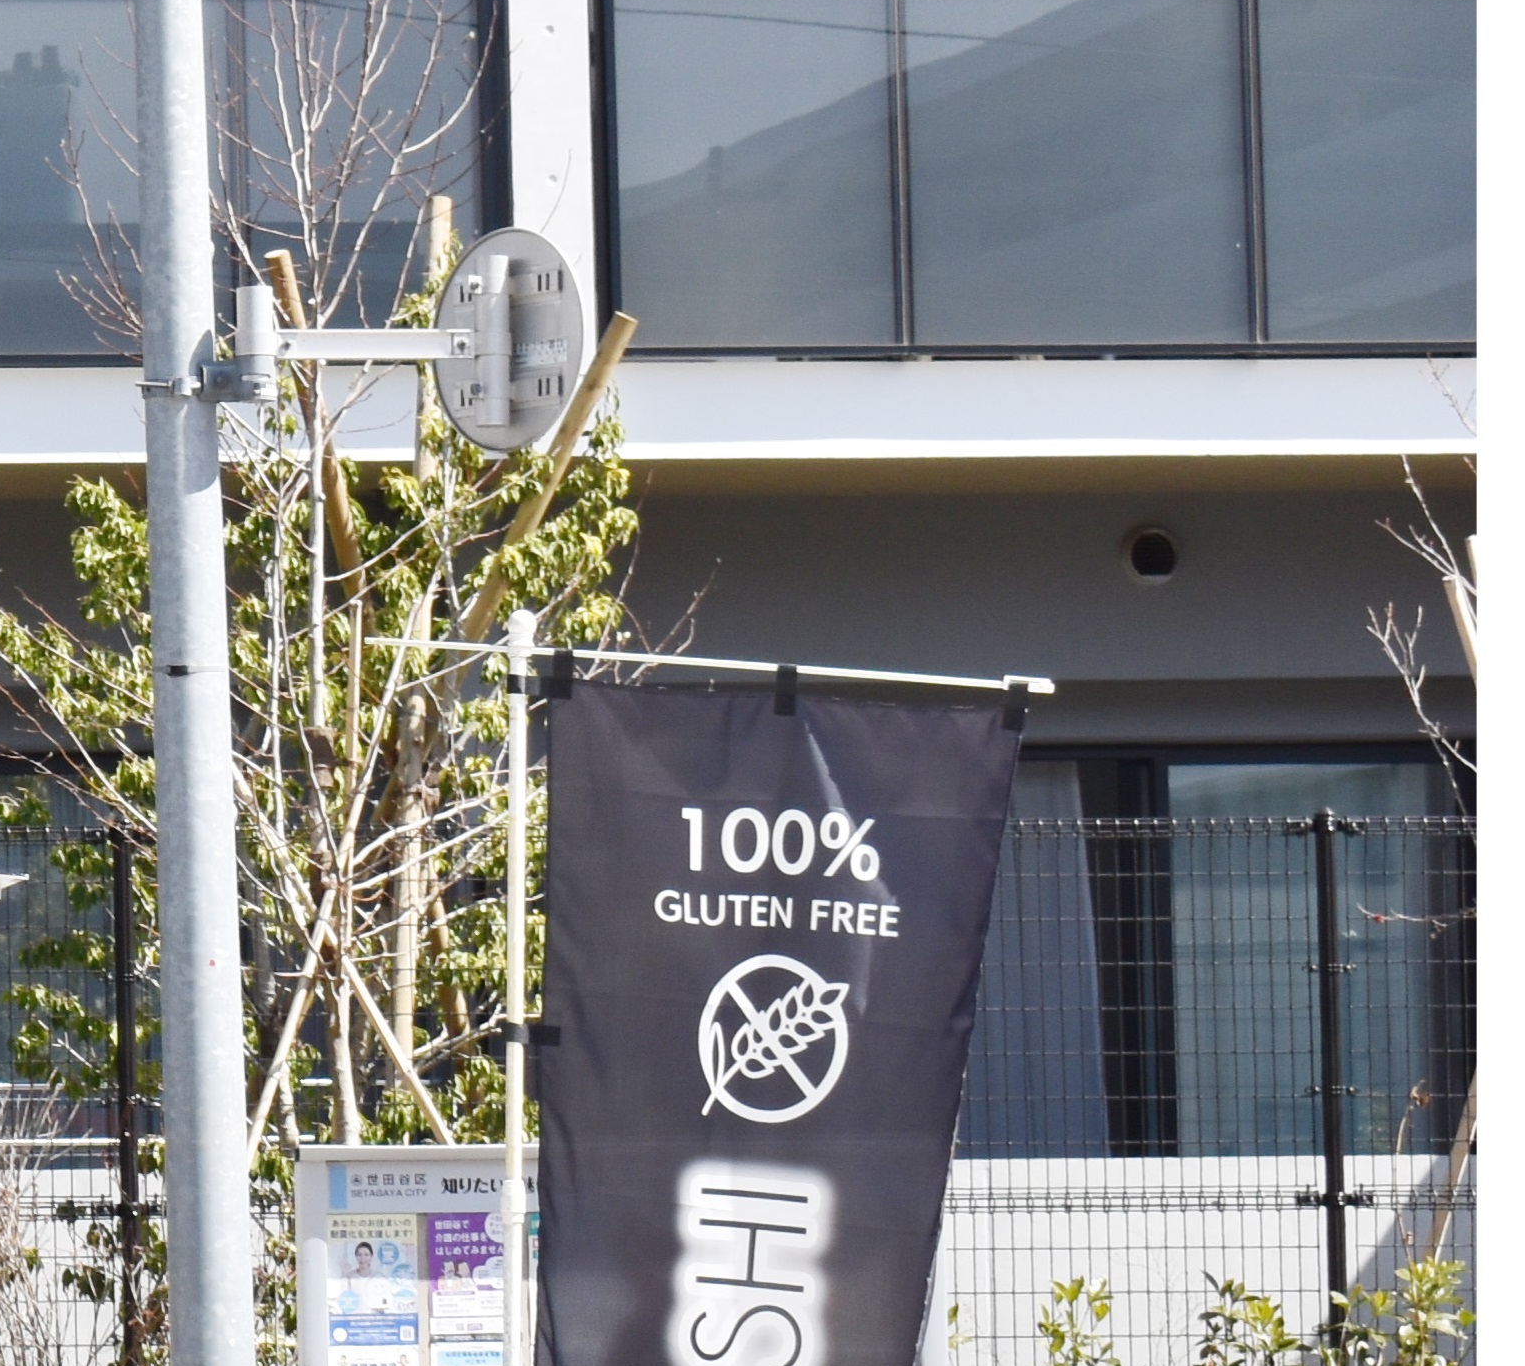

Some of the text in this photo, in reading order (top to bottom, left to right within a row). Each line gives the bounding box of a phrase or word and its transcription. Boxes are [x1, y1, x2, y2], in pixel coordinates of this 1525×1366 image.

[681, 807, 880, 881] 100%
[654, 890, 900, 938] GLUTEN FREE
[367, 1173, 427, 1185] 世田谷区
[405, 1188, 427, 1197] CITY
